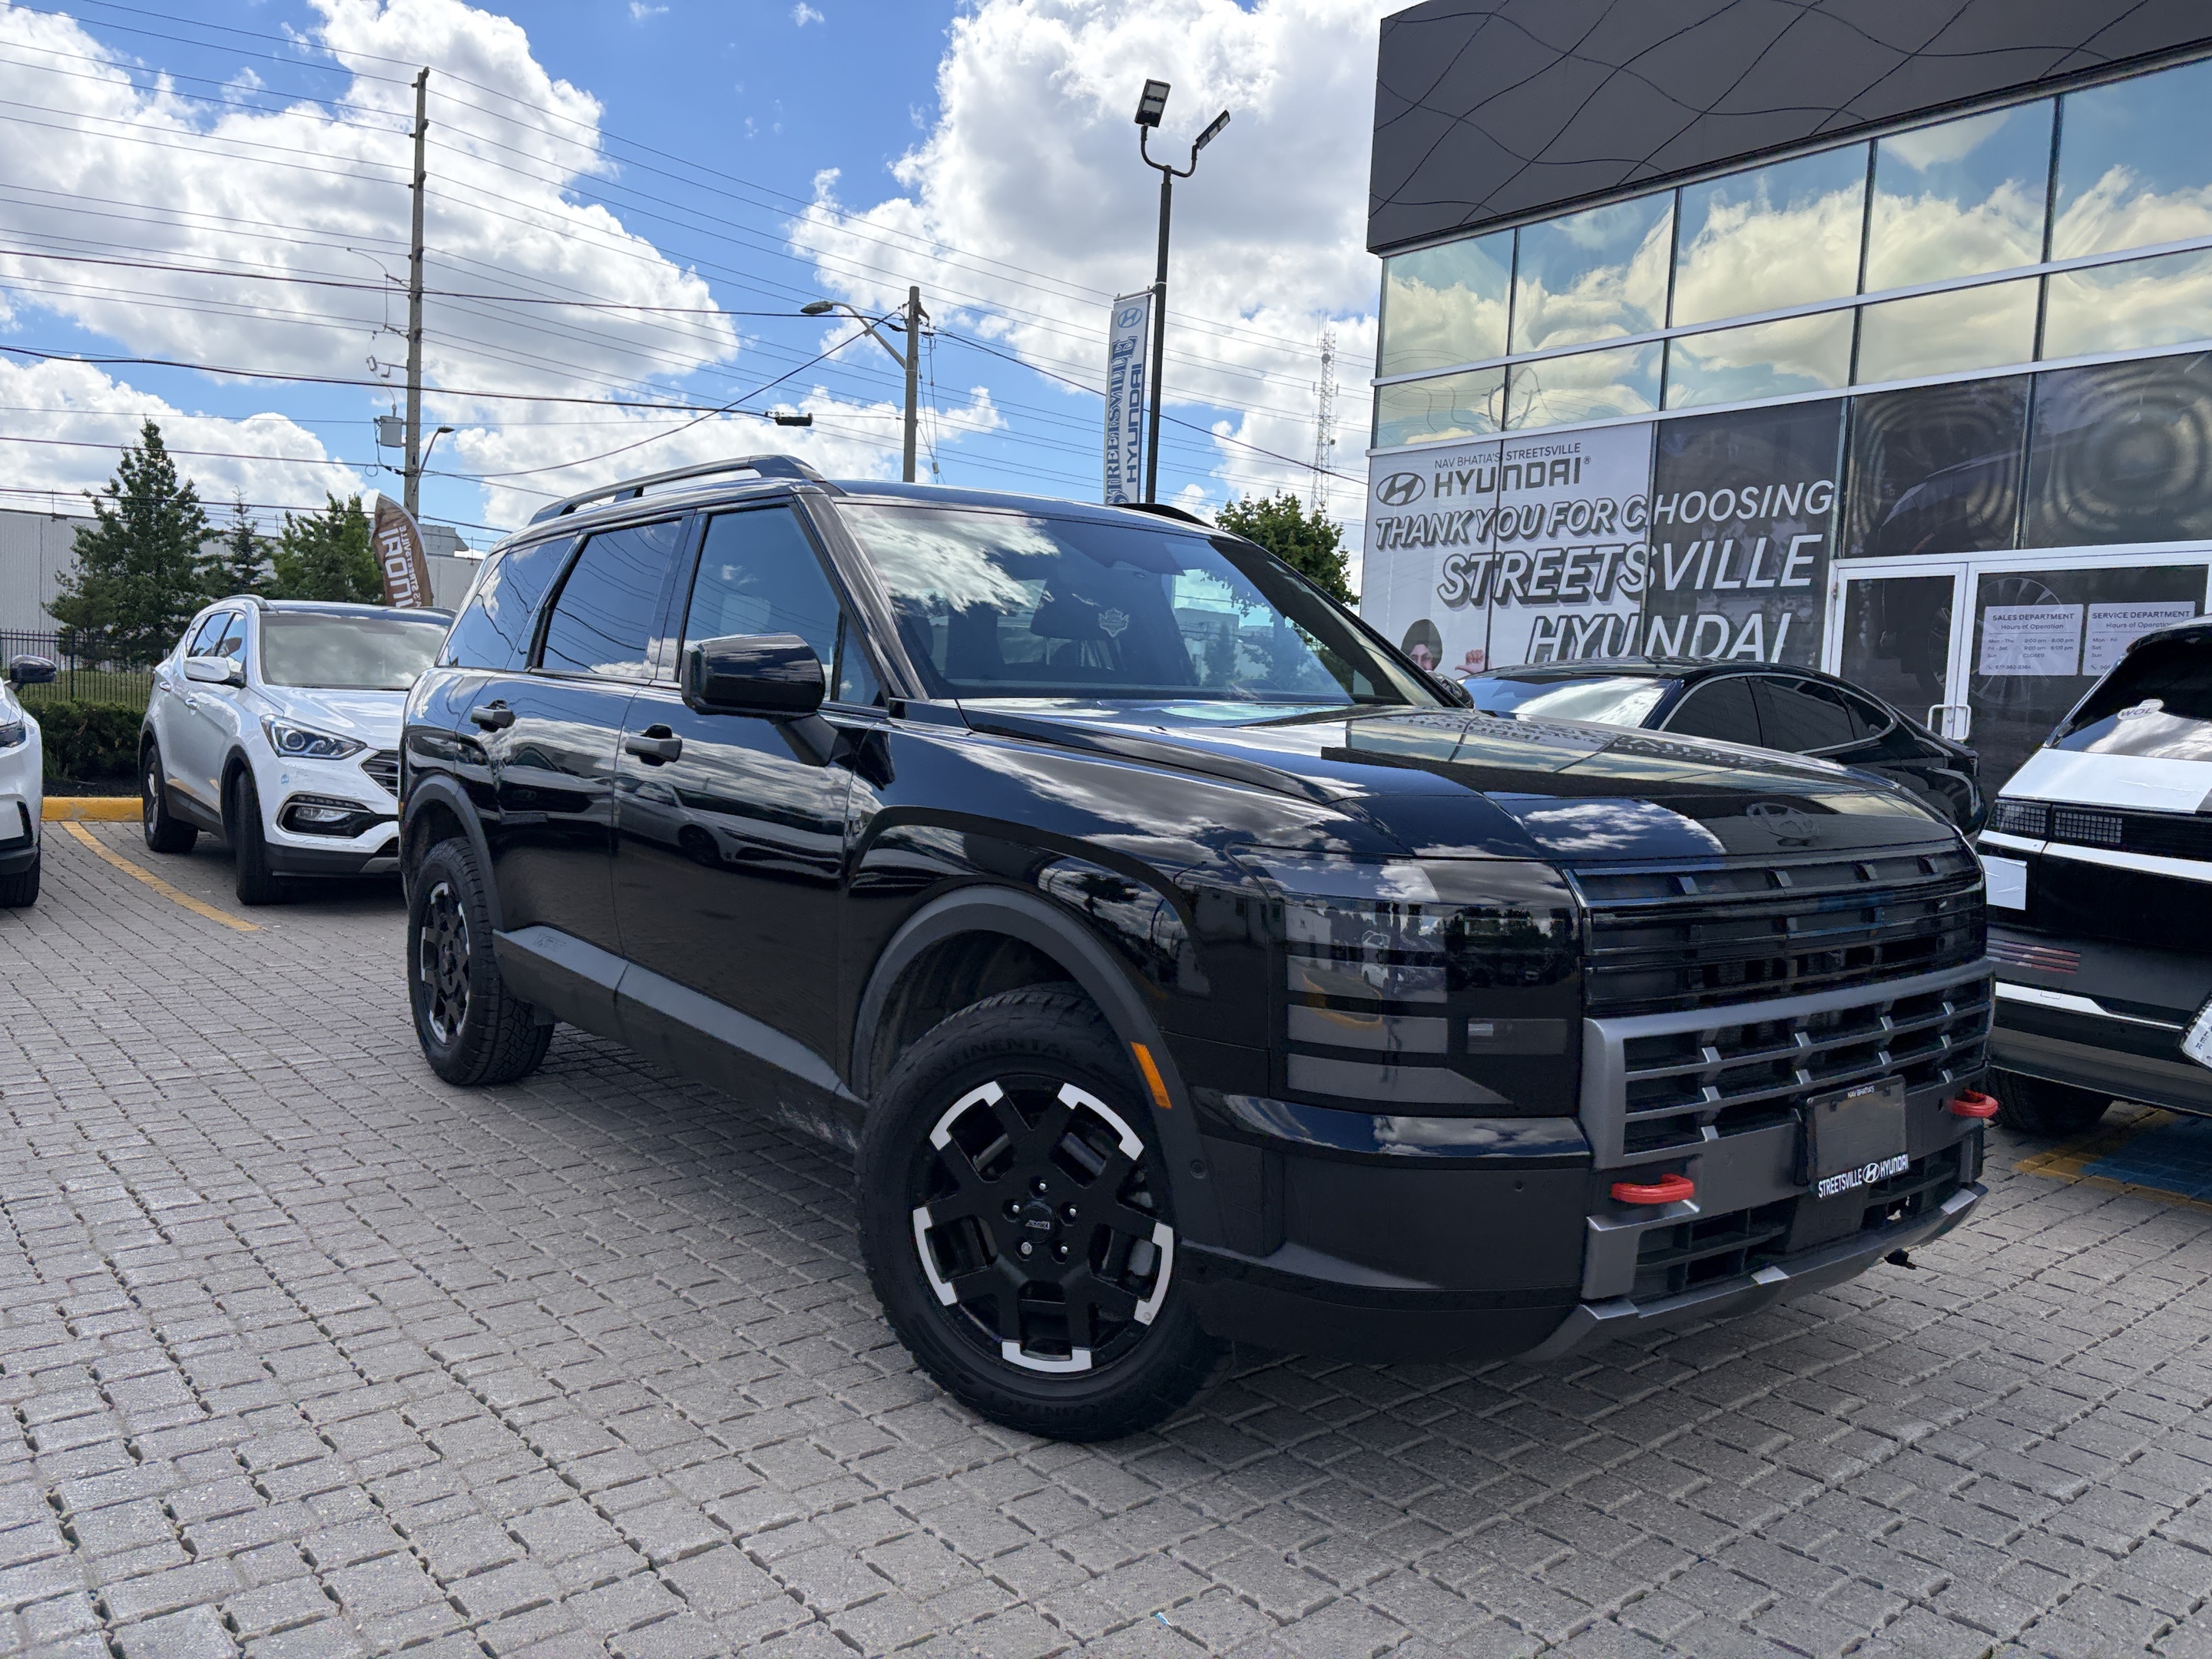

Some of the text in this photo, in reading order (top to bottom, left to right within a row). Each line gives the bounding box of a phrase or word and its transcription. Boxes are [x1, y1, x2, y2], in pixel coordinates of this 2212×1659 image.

[1127, 363, 1142, 483] HYUNDAI
[1435, 442, 1581, 469] NAV BHATIA'S STREETSVILLE
[1376, 479, 1835, 551] THANK YOU FOR CHOOSING
[1437, 533, 1823, 611] STREETSVILLE
[1524, 611, 1793, 664] HYUNDAI
[2137, 621, 2173, 629] Operatio
[1818, 1154, 1909, 1199] STREETSVILLE HYUNDAI
